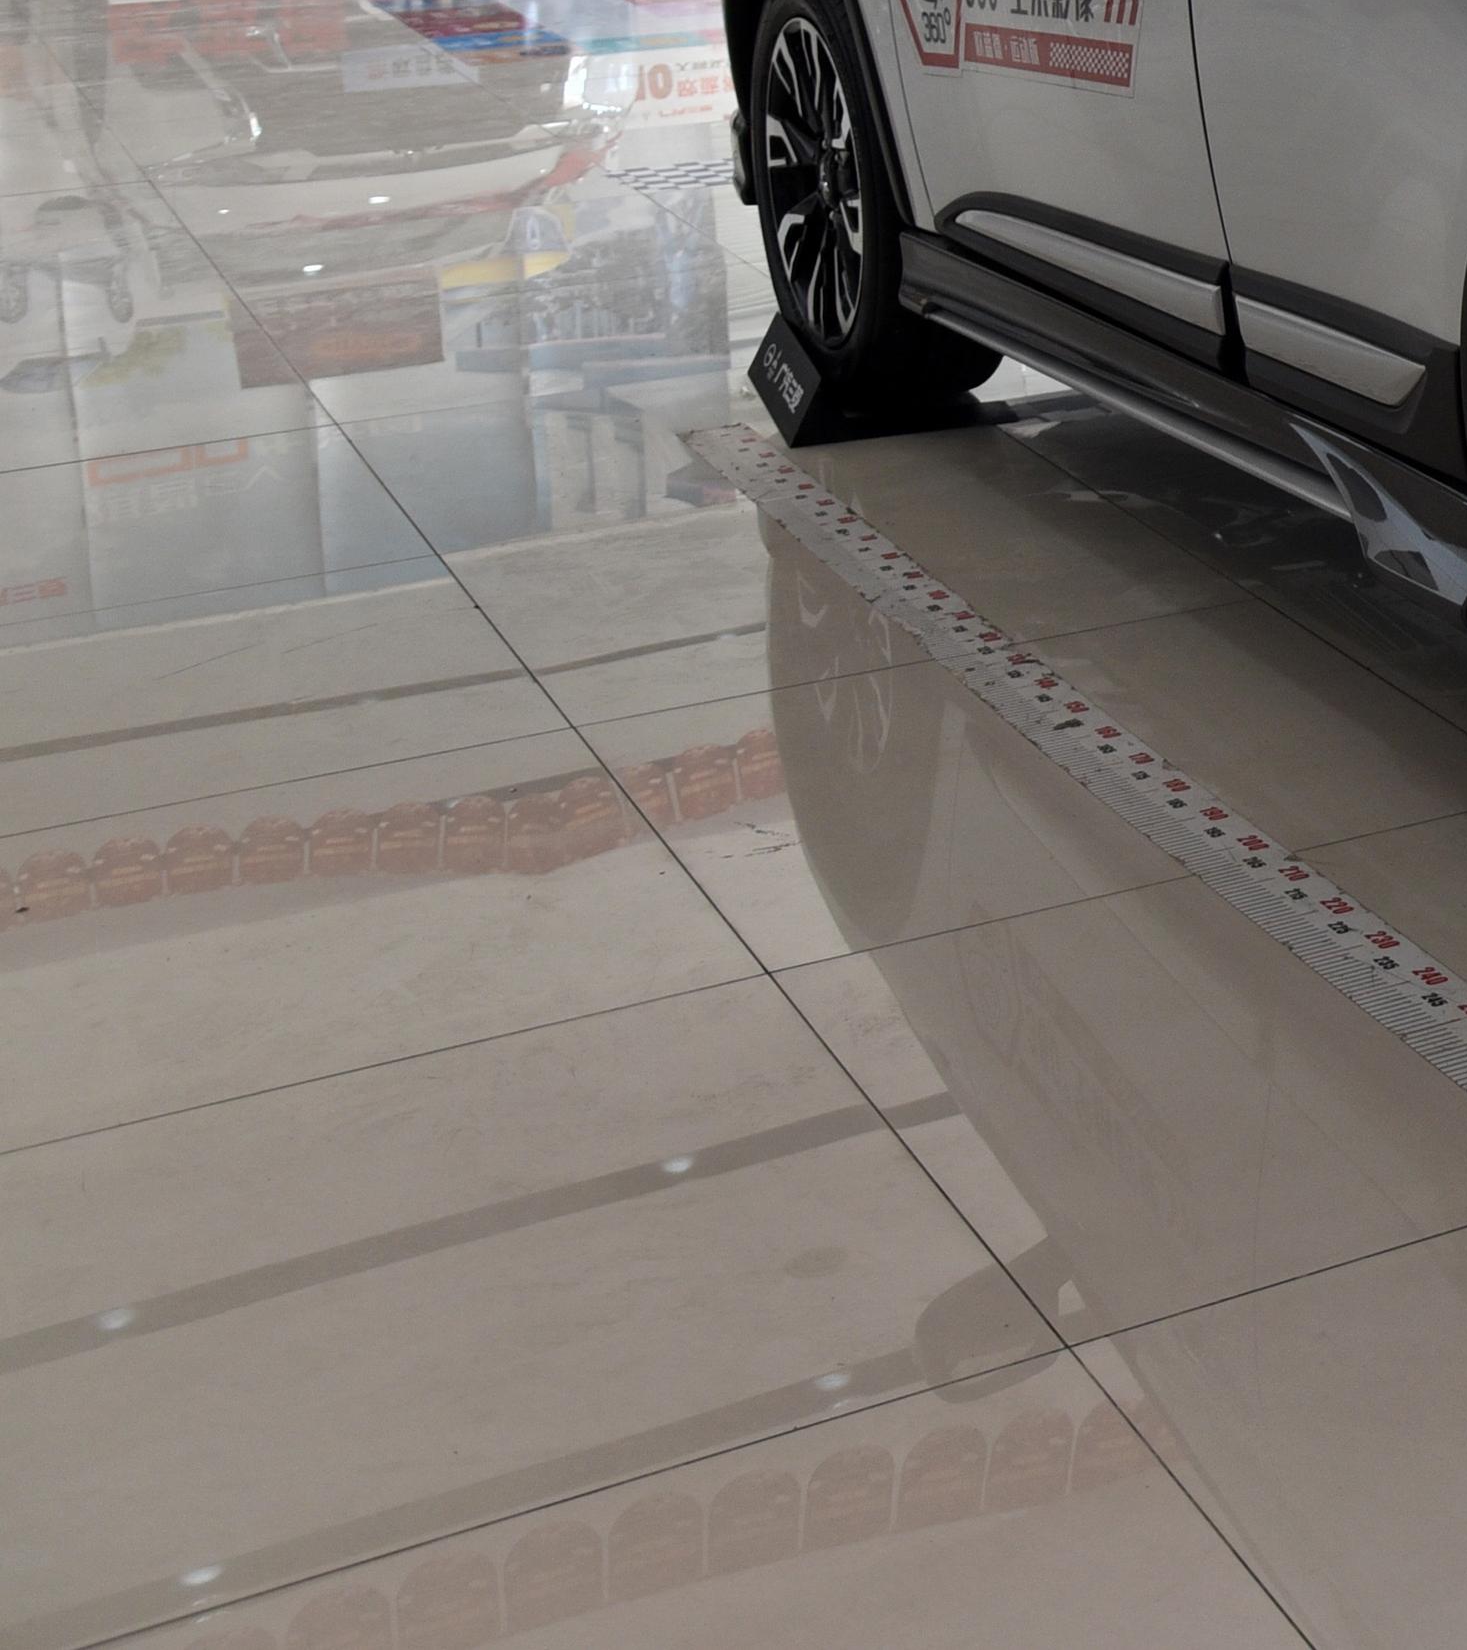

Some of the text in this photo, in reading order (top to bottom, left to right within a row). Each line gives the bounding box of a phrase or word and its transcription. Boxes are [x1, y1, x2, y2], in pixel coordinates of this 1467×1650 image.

[1200, 806, 1229, 821] 190
[1236, 834, 1270, 851] 200
[1278, 865, 1310, 882] 210
[1319, 896, 1355, 915] 220
[1327, 921, 1351, 935] 225
[1364, 930, 1400, 950] 230
[1373, 956, 1400, 970] 235
[1411, 966, 1449, 986] 240
[1421, 992, 1448, 1007] 245
